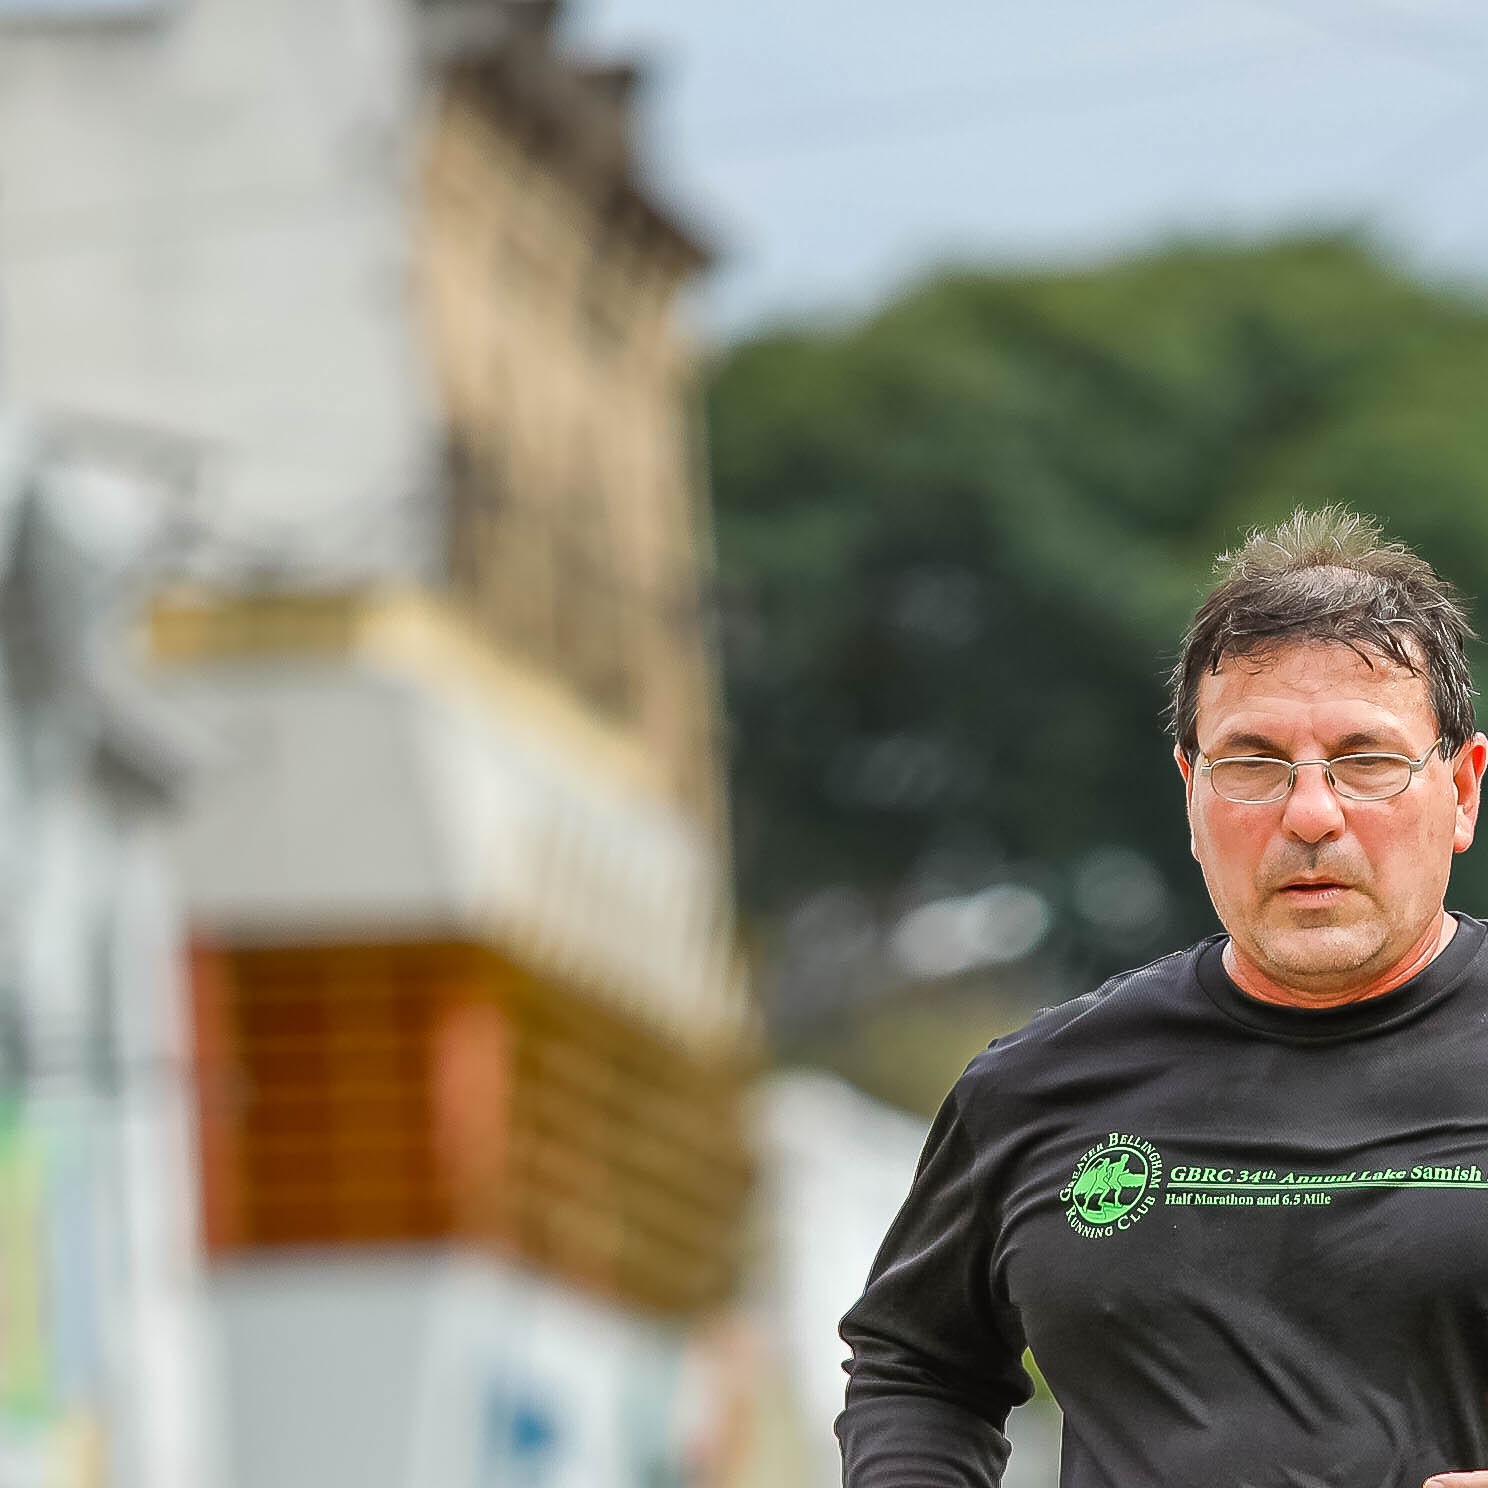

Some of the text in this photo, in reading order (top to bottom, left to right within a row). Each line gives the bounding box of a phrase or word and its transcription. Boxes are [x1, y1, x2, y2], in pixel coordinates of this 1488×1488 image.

[1106, 1132, 1162, 1189] BELLINGHAM
[1170, 1166, 1234, 1183] GBRC
[1236, 1170, 1277, 1184] 34th
[1278, 1171, 1356, 1184] Annual
[1358, 1168, 1407, 1181] Lake
[1410, 1165, 1482, 1182] Samish
[1164, 1192, 1332, 1206] Half Marathon and 6.5 Mile
[1065, 1195, 1156, 1239] RUNNING CLUB
